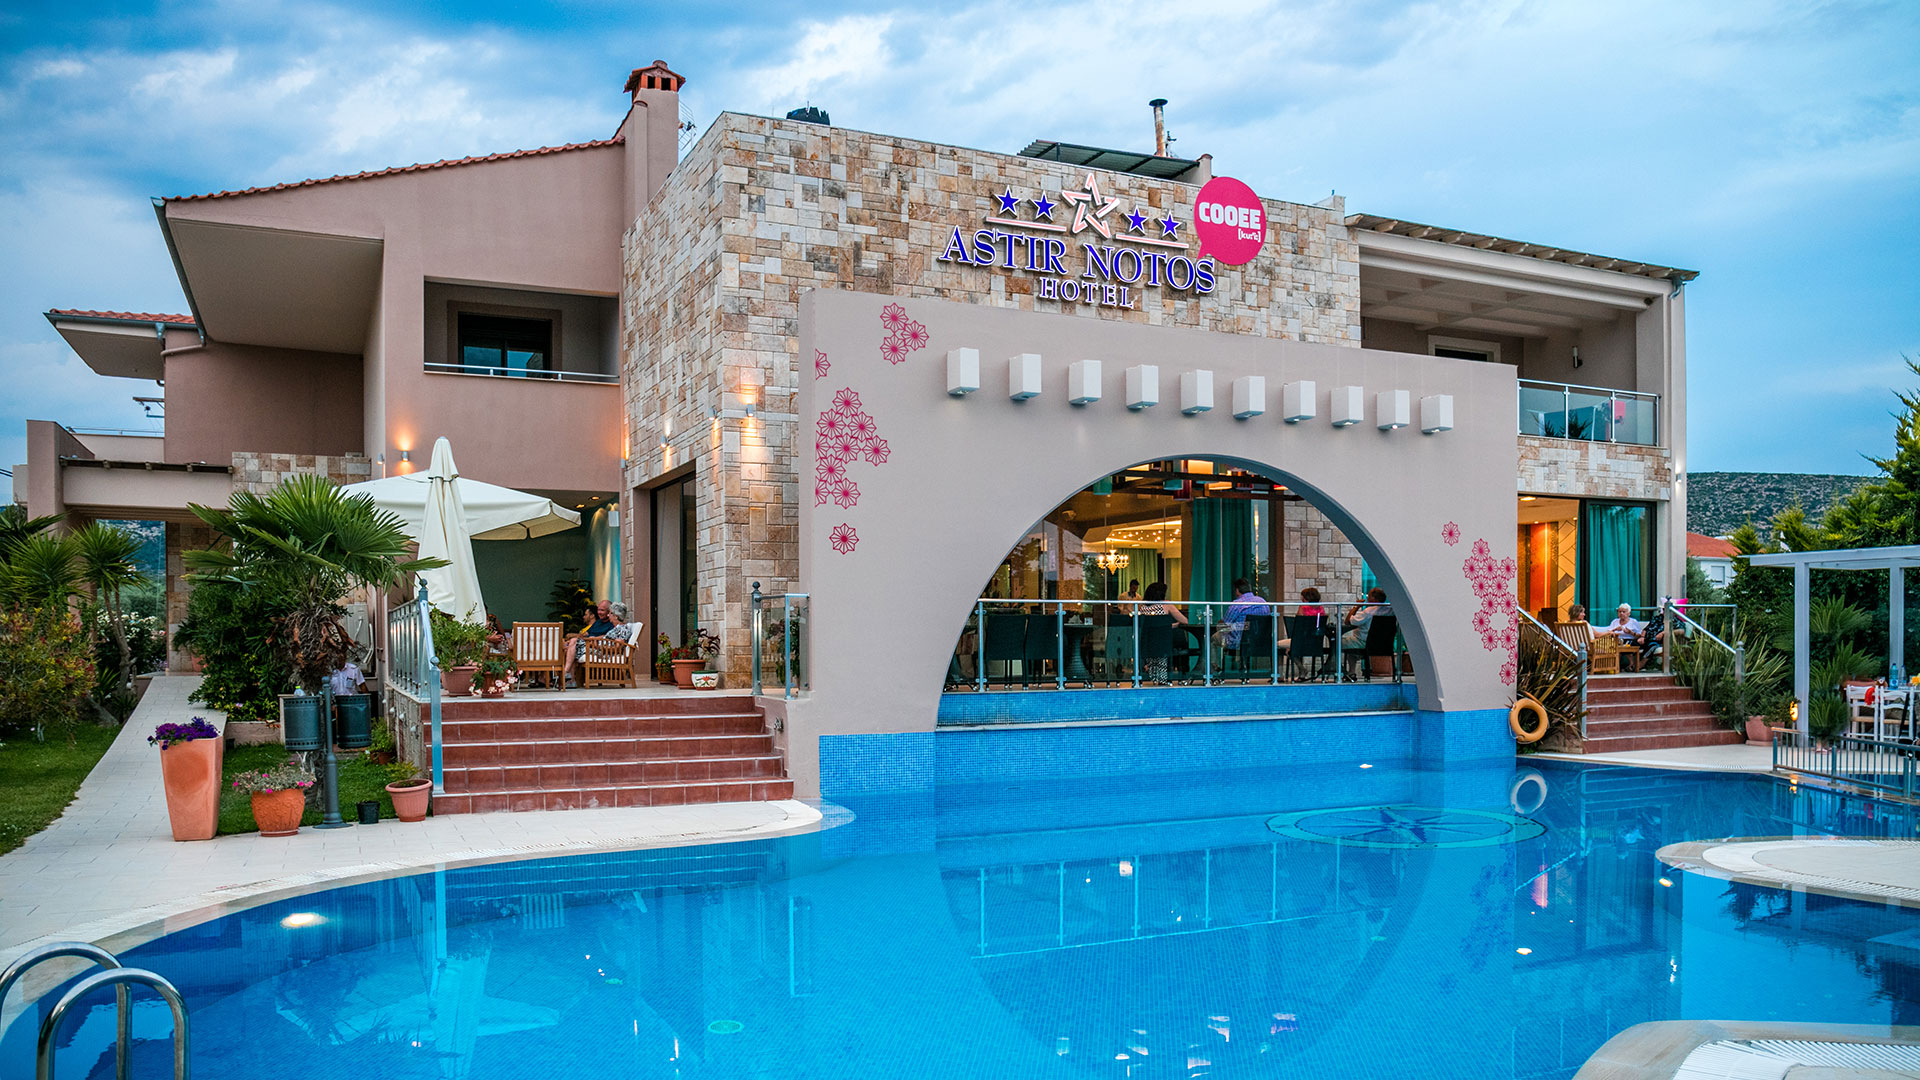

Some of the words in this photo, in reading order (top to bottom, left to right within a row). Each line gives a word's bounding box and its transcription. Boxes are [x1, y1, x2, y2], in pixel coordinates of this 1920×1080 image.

[1198, 202, 1261, 230] COOEE
[939, 224, 1068, 275] ASTIR
[1083, 242, 1216, 294] NOTOS
[1039, 277, 1135, 310] HOTEL
